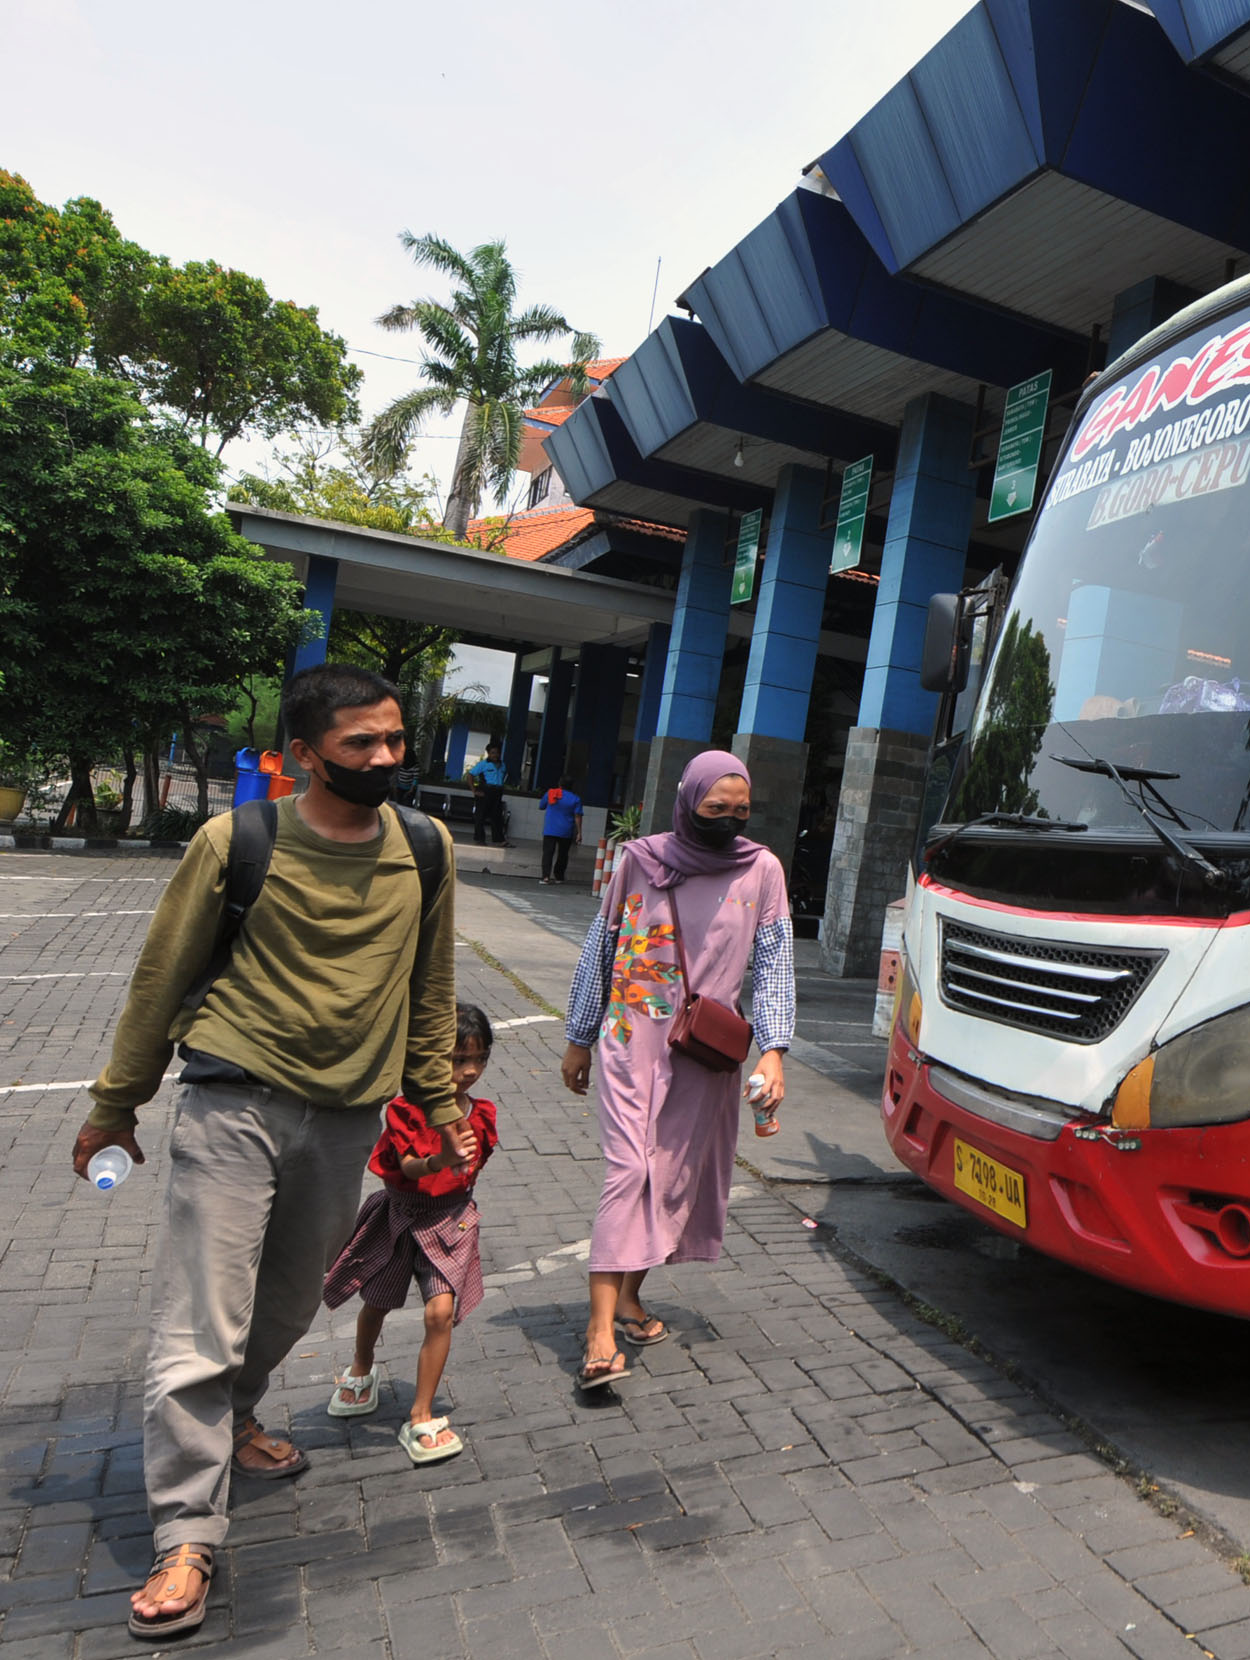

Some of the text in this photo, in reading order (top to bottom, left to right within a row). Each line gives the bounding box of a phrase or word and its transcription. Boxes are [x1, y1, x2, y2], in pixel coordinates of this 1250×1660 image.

[1045, 449, 1117, 511] SURABAYA
[956, 1144, 963, 1172] S
[1004, 1174, 1022, 1209] UA
